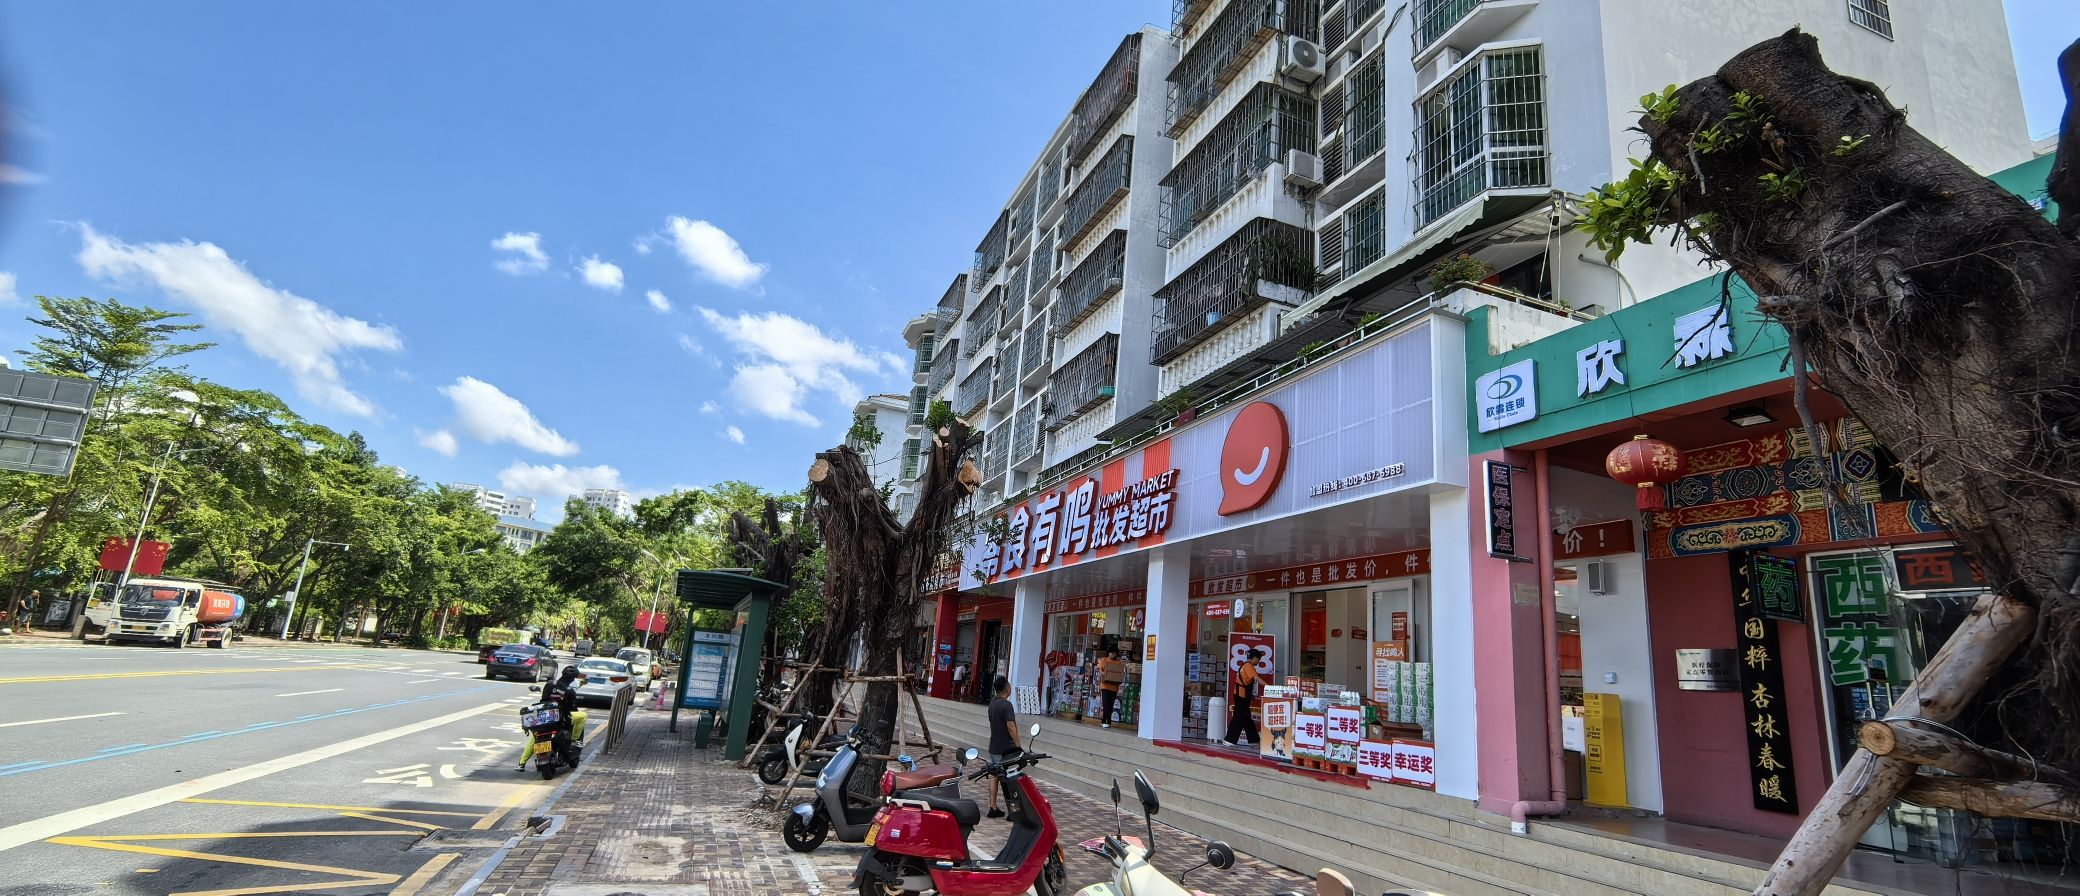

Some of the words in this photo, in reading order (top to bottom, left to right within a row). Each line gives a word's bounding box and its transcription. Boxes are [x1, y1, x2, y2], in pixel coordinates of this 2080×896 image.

[1099, 485, 1129, 506] YUMMY
[1132, 469, 1176, 499] MARKET
[1091, 491, 1173, 549] 批发超市
[1491, 464, 1513, 552] 医保定点
[1207, 577, 1243, 594] 批发超市
[1759, 562, 1796, 612] 药
[1817, 556, 1899, 687] 西药
[1297, 722, 1323, 738] 一等奖
[1329, 716, 1359, 734] 二等奖
[1358, 749, 1391, 769] 三等奖
[1394, 752, 1433, 775] 幸运奖
